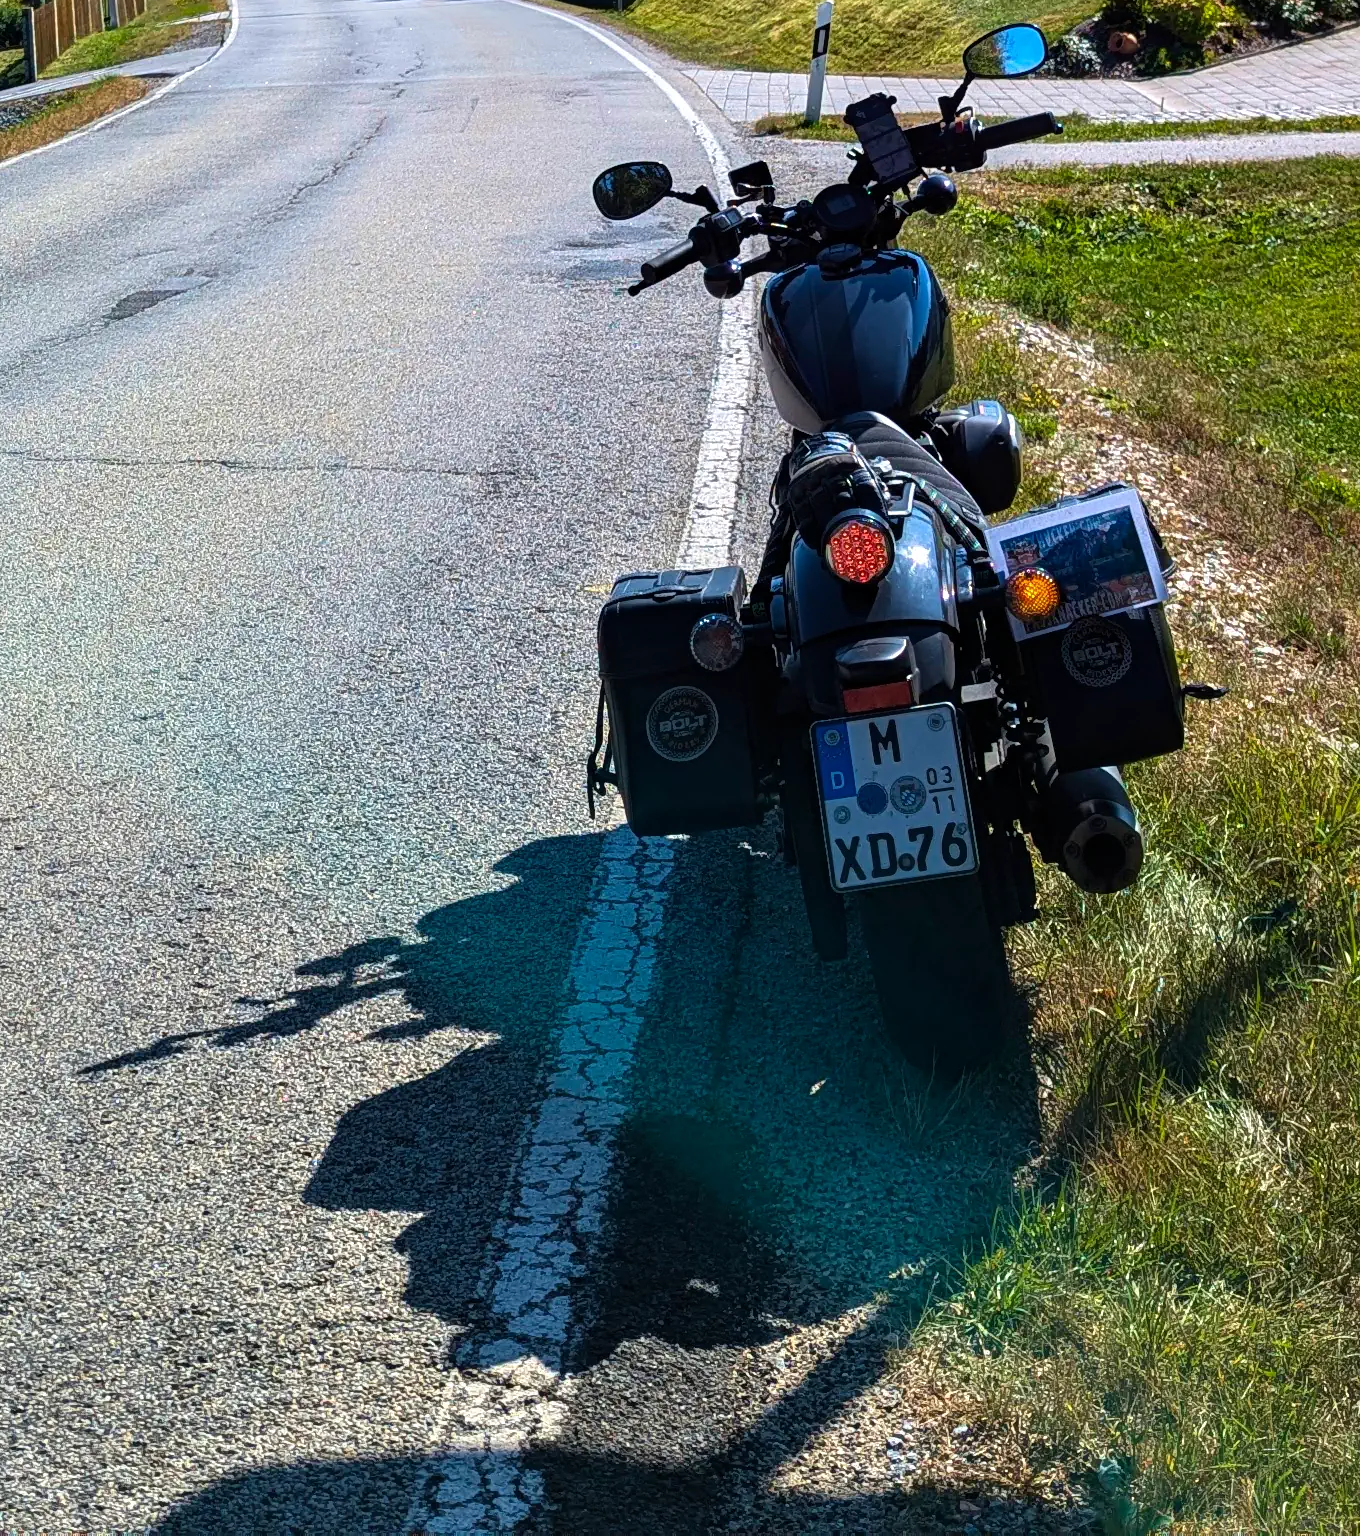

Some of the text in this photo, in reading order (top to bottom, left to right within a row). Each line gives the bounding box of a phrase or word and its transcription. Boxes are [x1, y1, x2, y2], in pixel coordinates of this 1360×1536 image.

[1071, 642, 1120, 662] BOLT
[659, 714, 708, 733] BOLT
[868, 719, 902, 765] M
[830, 771, 846, 790] D
[925, 765, 953, 786] 03
[932, 794, 956, 815] 11
